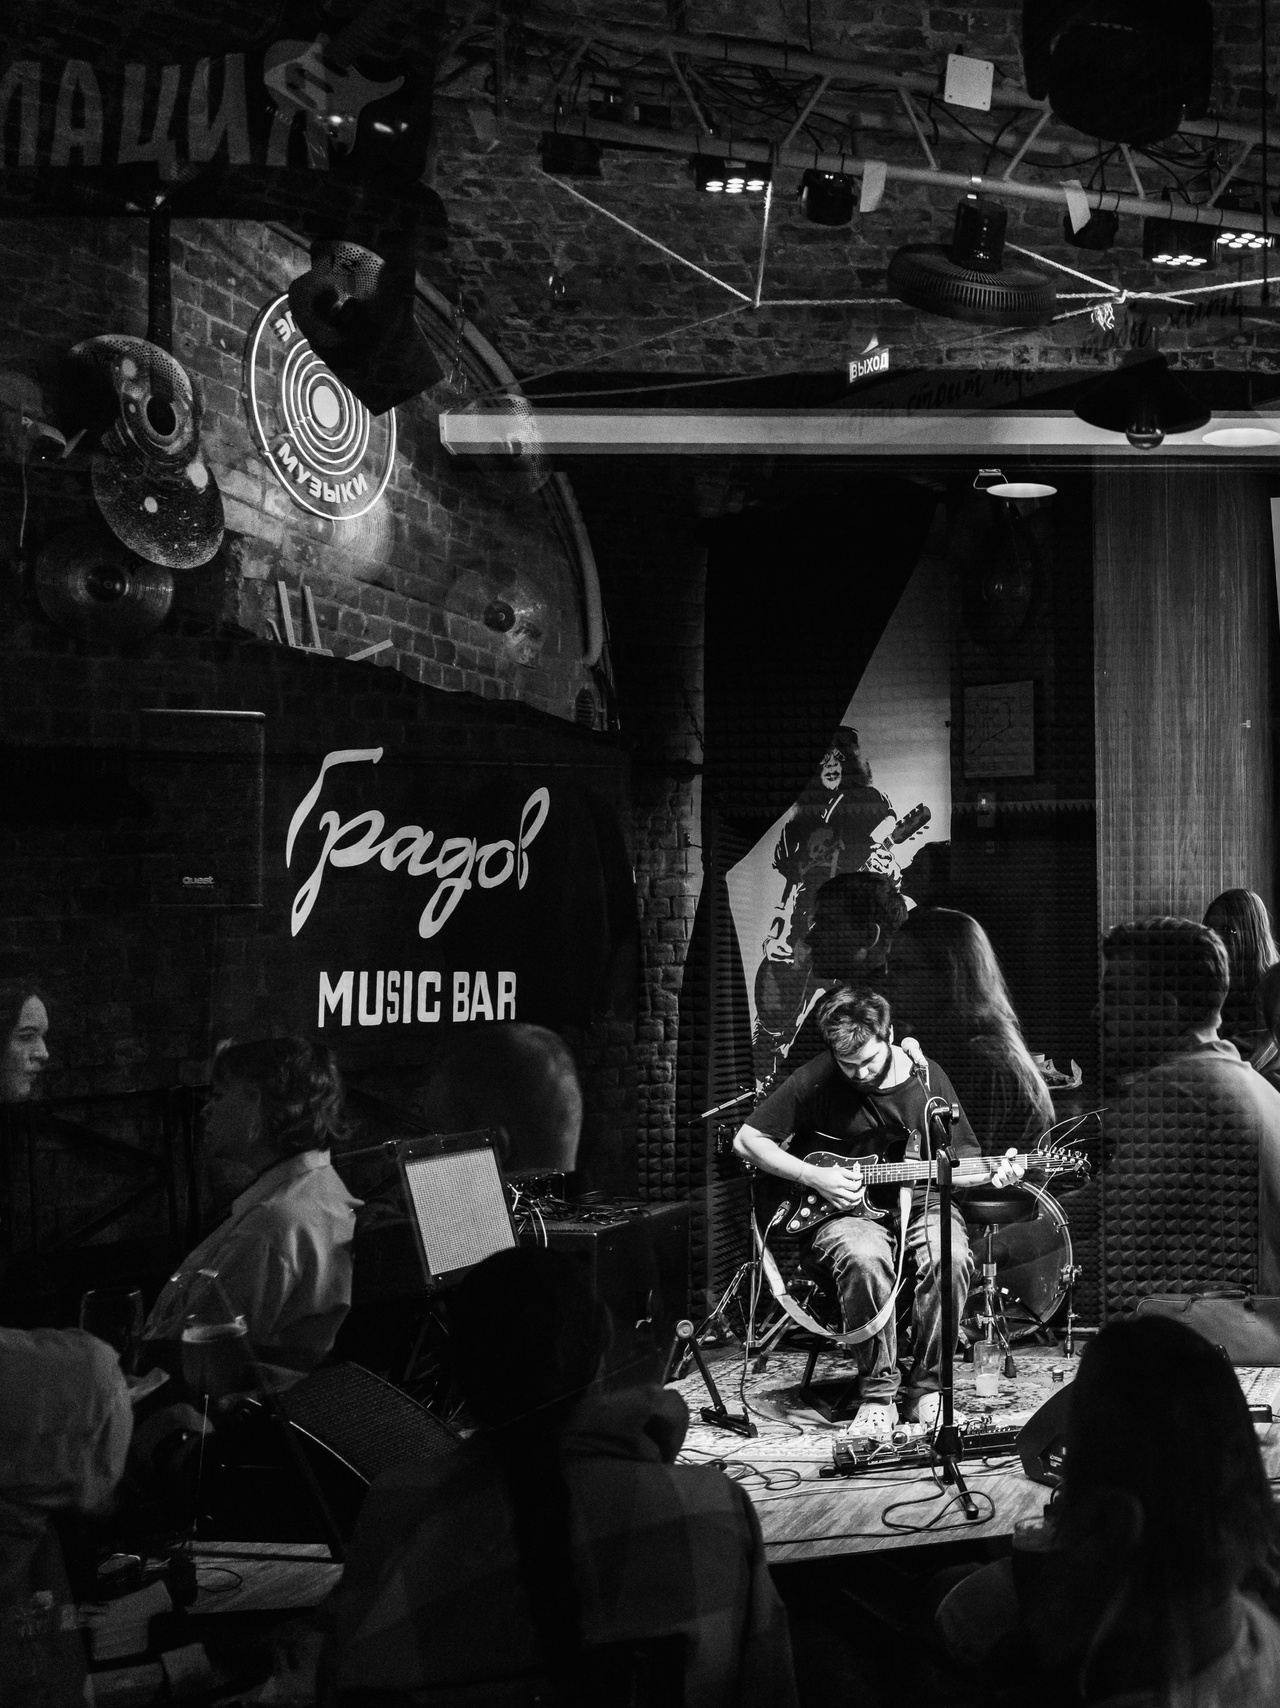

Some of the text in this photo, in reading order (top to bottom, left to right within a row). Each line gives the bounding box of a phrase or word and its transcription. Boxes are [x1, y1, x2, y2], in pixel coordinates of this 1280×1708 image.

[850, 351, 889, 380] ВЫХОД
[278, 442, 369, 504] МУЗЫКИ
[317, 970, 518, 1028] MUSIC BAR
